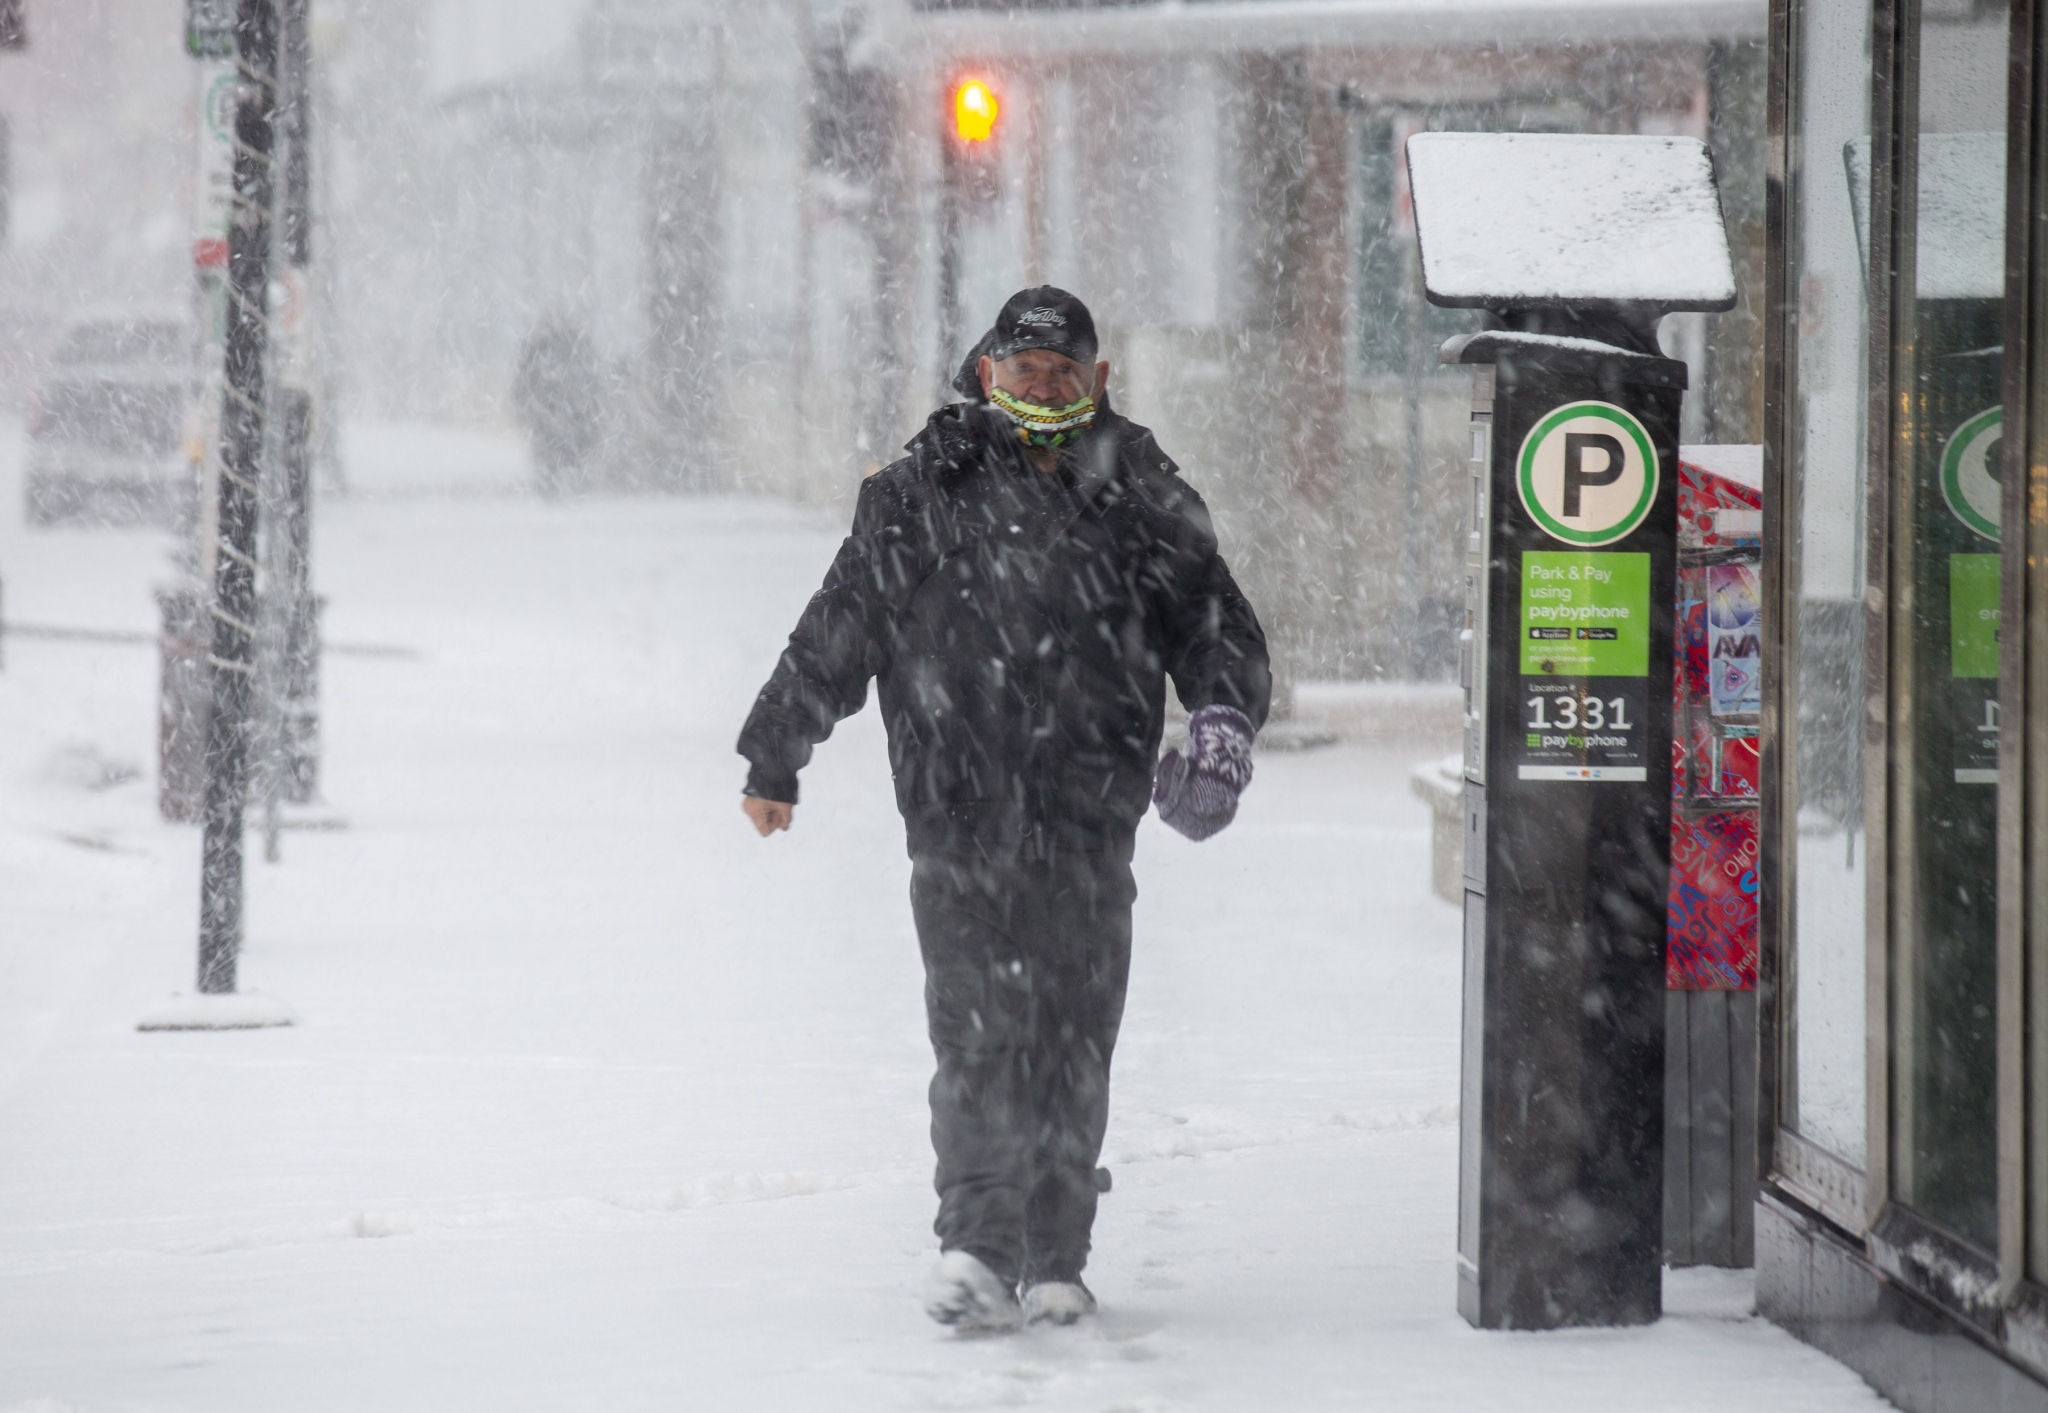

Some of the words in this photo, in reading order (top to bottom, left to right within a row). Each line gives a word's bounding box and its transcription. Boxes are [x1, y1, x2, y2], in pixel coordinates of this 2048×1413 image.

[1563, 432, 1626, 518] P
[1530, 565, 1565, 580] Park
[1567, 565, 1580, 580] &
[1584, 566, 1612, 583] Pay
[1529, 585, 1572, 602] using
[1529, 603, 1630, 621] paybyphone
[1530, 684, 1568, 692] Location
[1527, 696, 1632, 730] 1331
[1542, 733, 1628, 748] paybyphone
